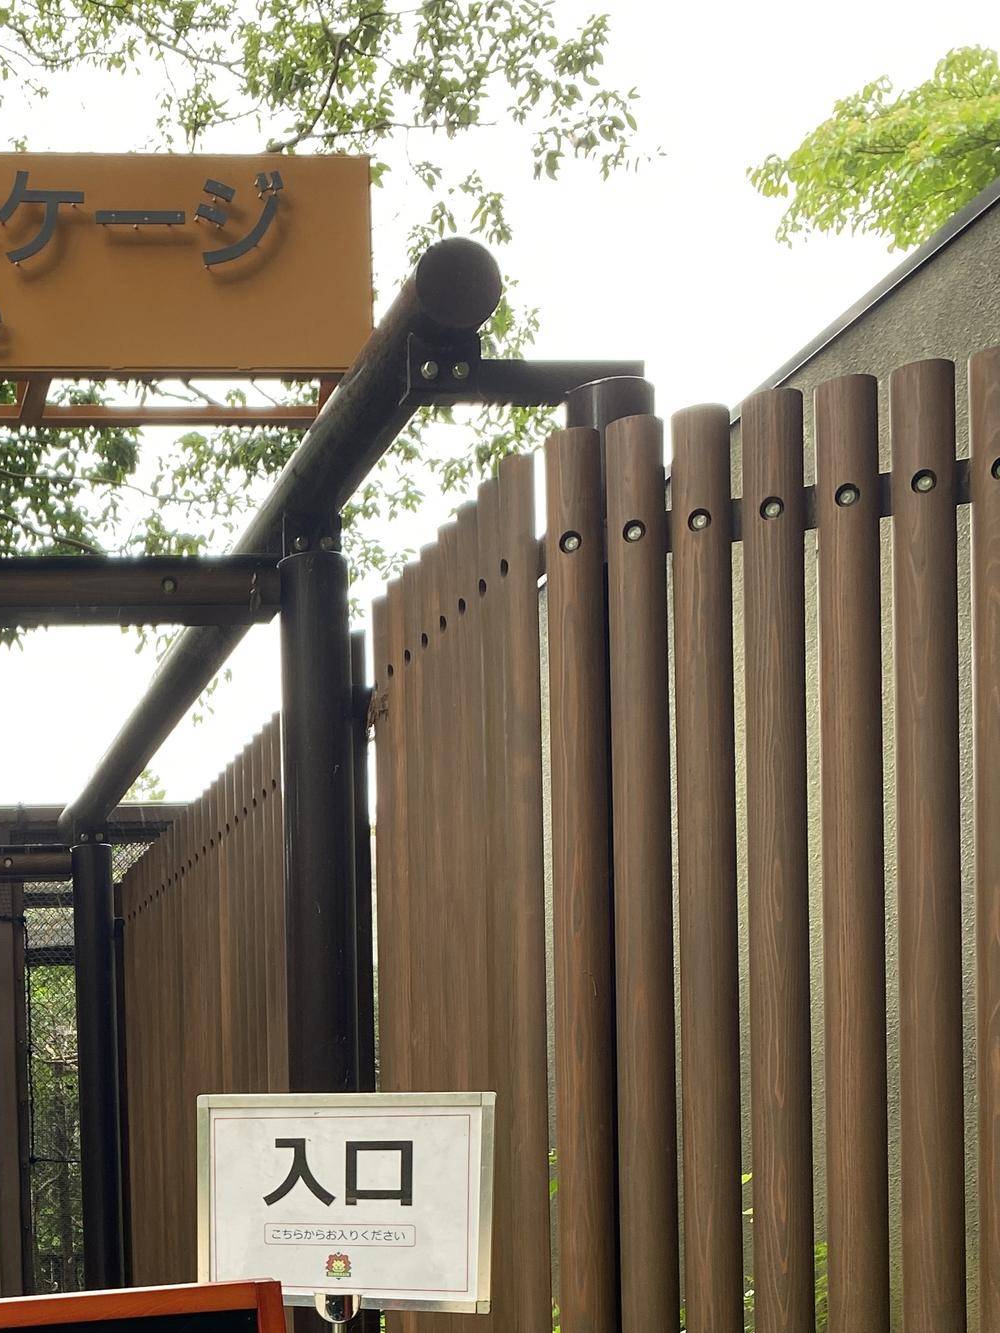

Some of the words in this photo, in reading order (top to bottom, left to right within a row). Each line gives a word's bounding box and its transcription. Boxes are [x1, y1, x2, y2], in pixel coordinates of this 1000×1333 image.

[263, 1138, 414, 1207] 入口
[271, 1228, 406, 1242] こちらからお入りください
